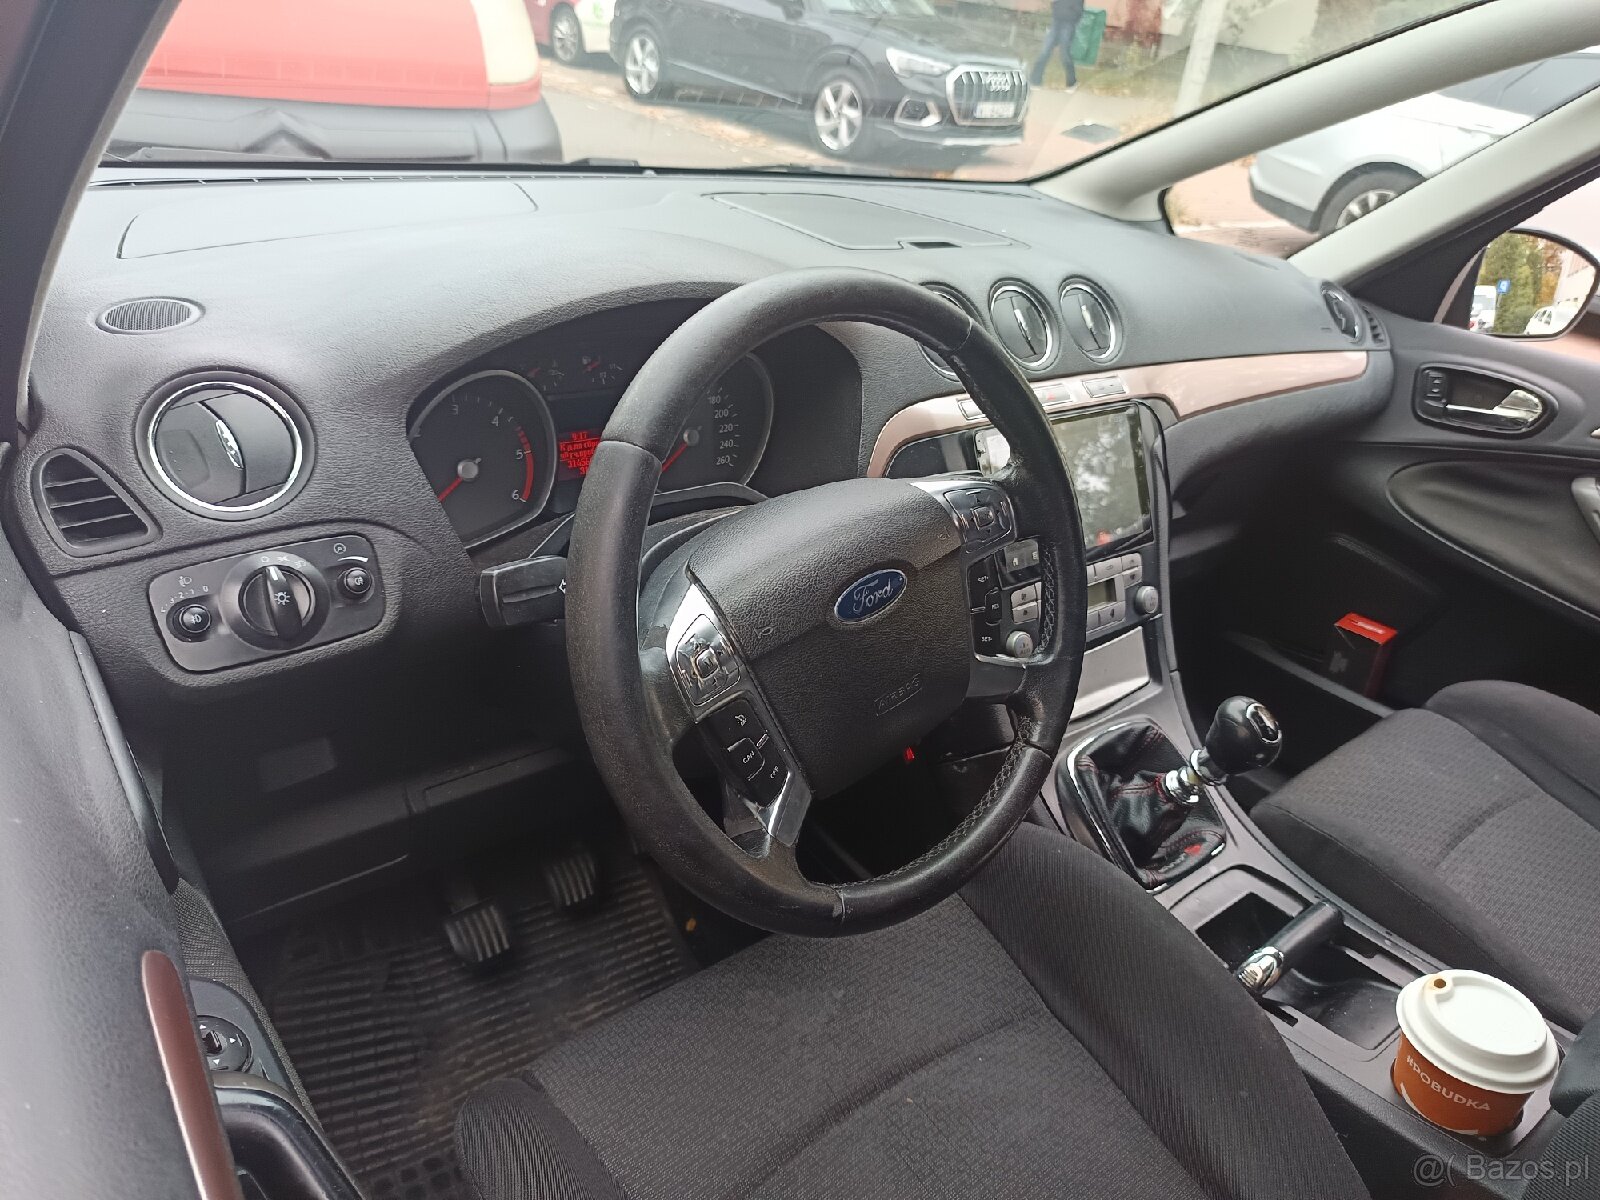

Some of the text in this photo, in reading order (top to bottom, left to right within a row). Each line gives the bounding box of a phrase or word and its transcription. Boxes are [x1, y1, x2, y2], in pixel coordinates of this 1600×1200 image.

[450, 404, 460, 416] 3
[714, 408, 729, 419] 200
[491, 415, 500, 427] 4
[719, 423, 734, 434] 220
[719, 439, 734, 450] 240
[515, 449, 524, 460] 5
[715, 454, 731, 466] 260
[511, 489, 520, 500] 6
[853, 578, 894, 615] Ford
[1406, 1054, 1491, 1111] #POBUDKA
